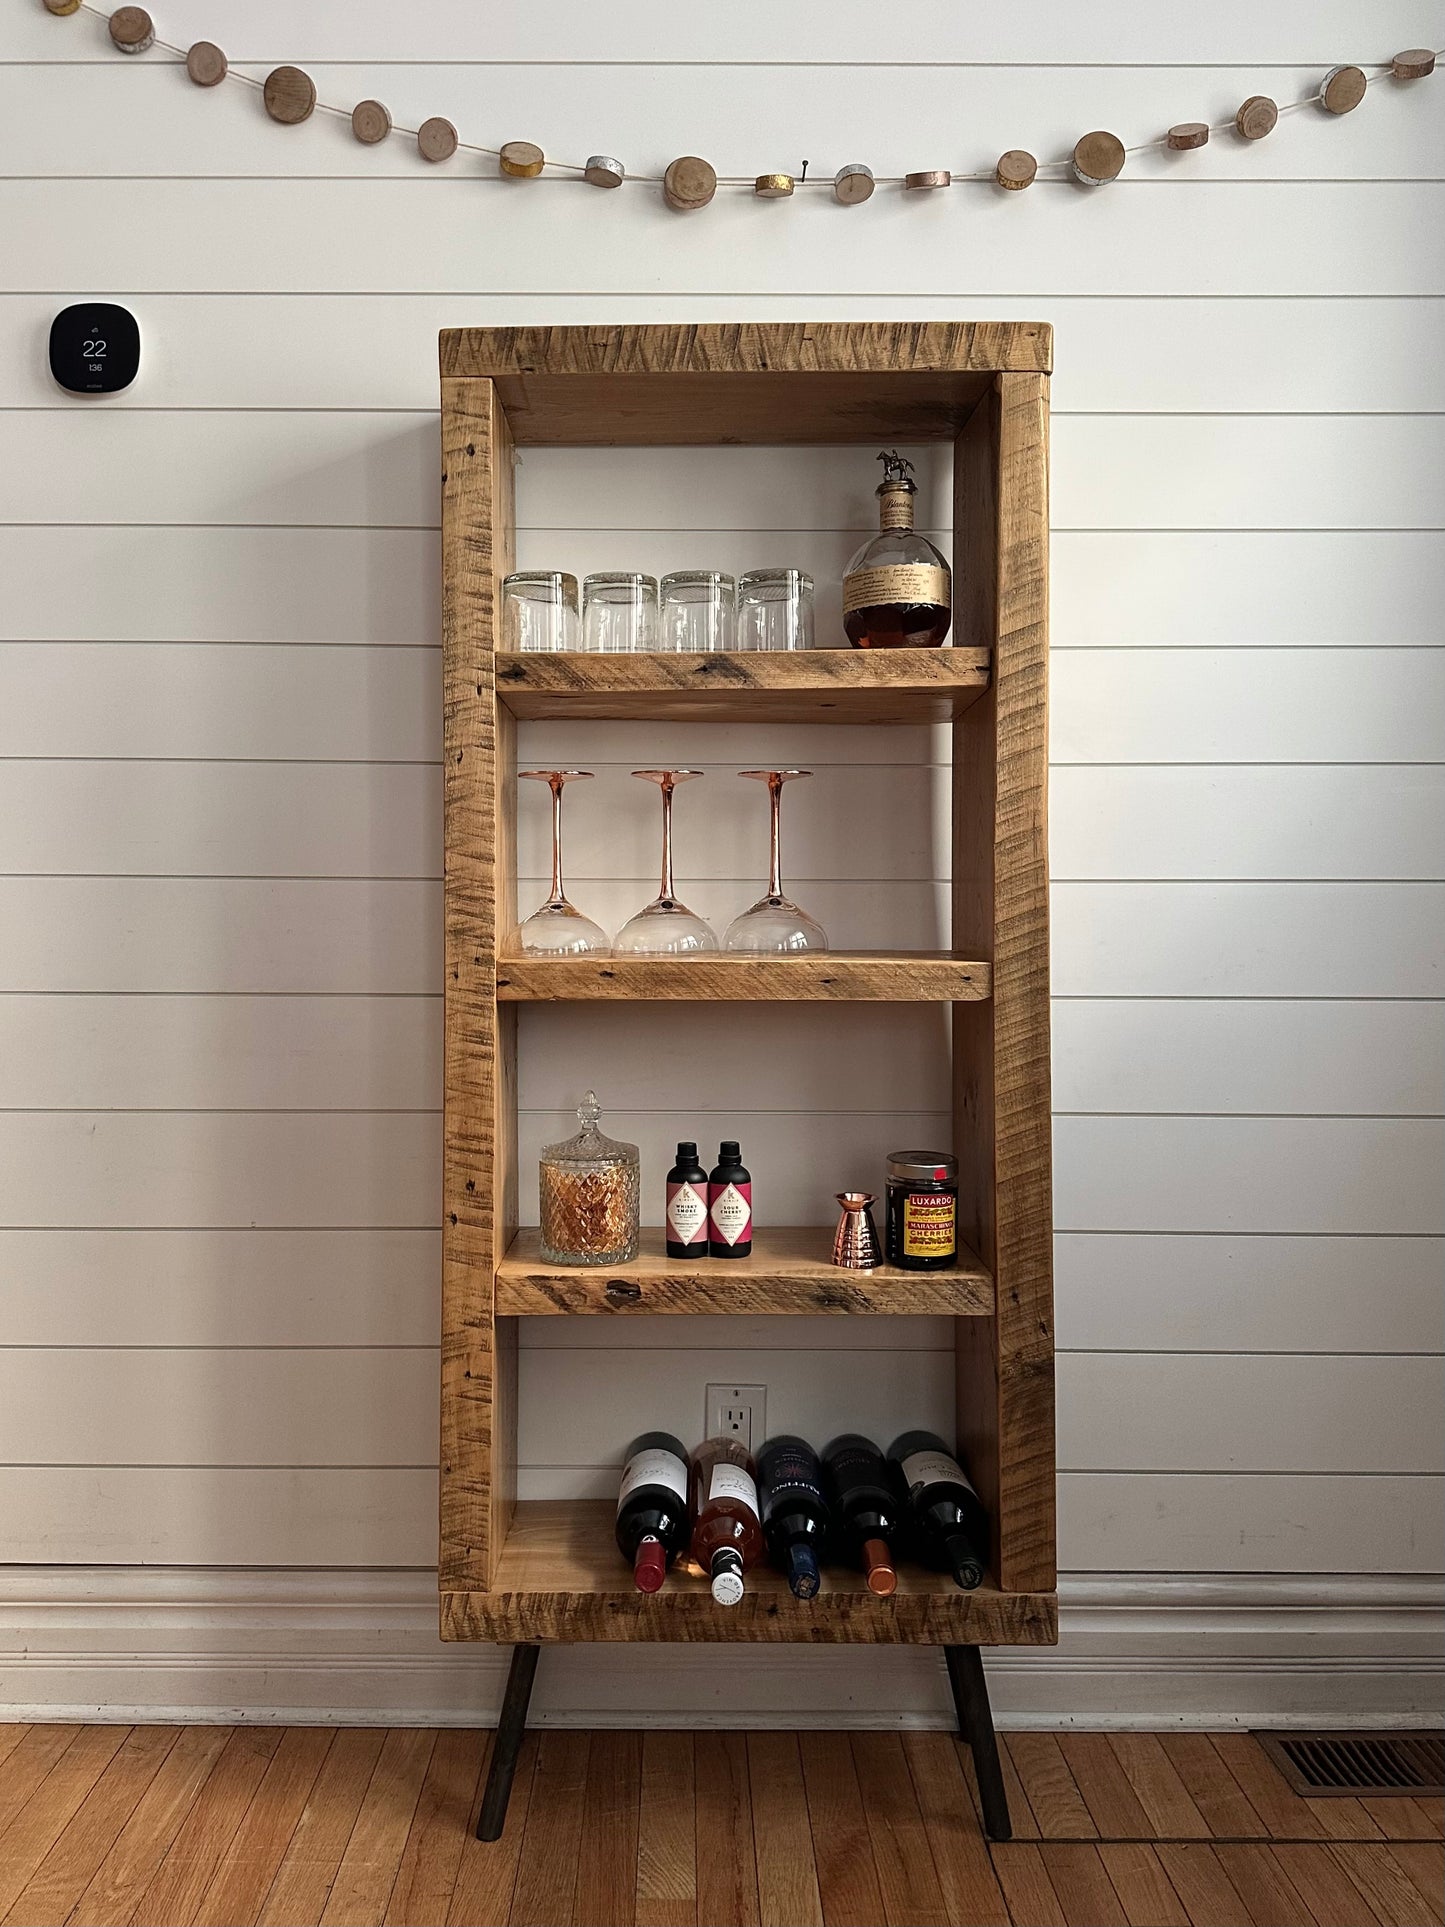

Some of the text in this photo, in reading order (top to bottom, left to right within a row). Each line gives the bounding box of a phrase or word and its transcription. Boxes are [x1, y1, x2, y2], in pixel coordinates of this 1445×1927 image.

[83, 340, 106, 357] 22
[912, 1196, 952, 1205] LUXARDO
[910, 1221, 953, 1229] MARASCHINO
[910, 1229, 952, 1237] CHERRIES
